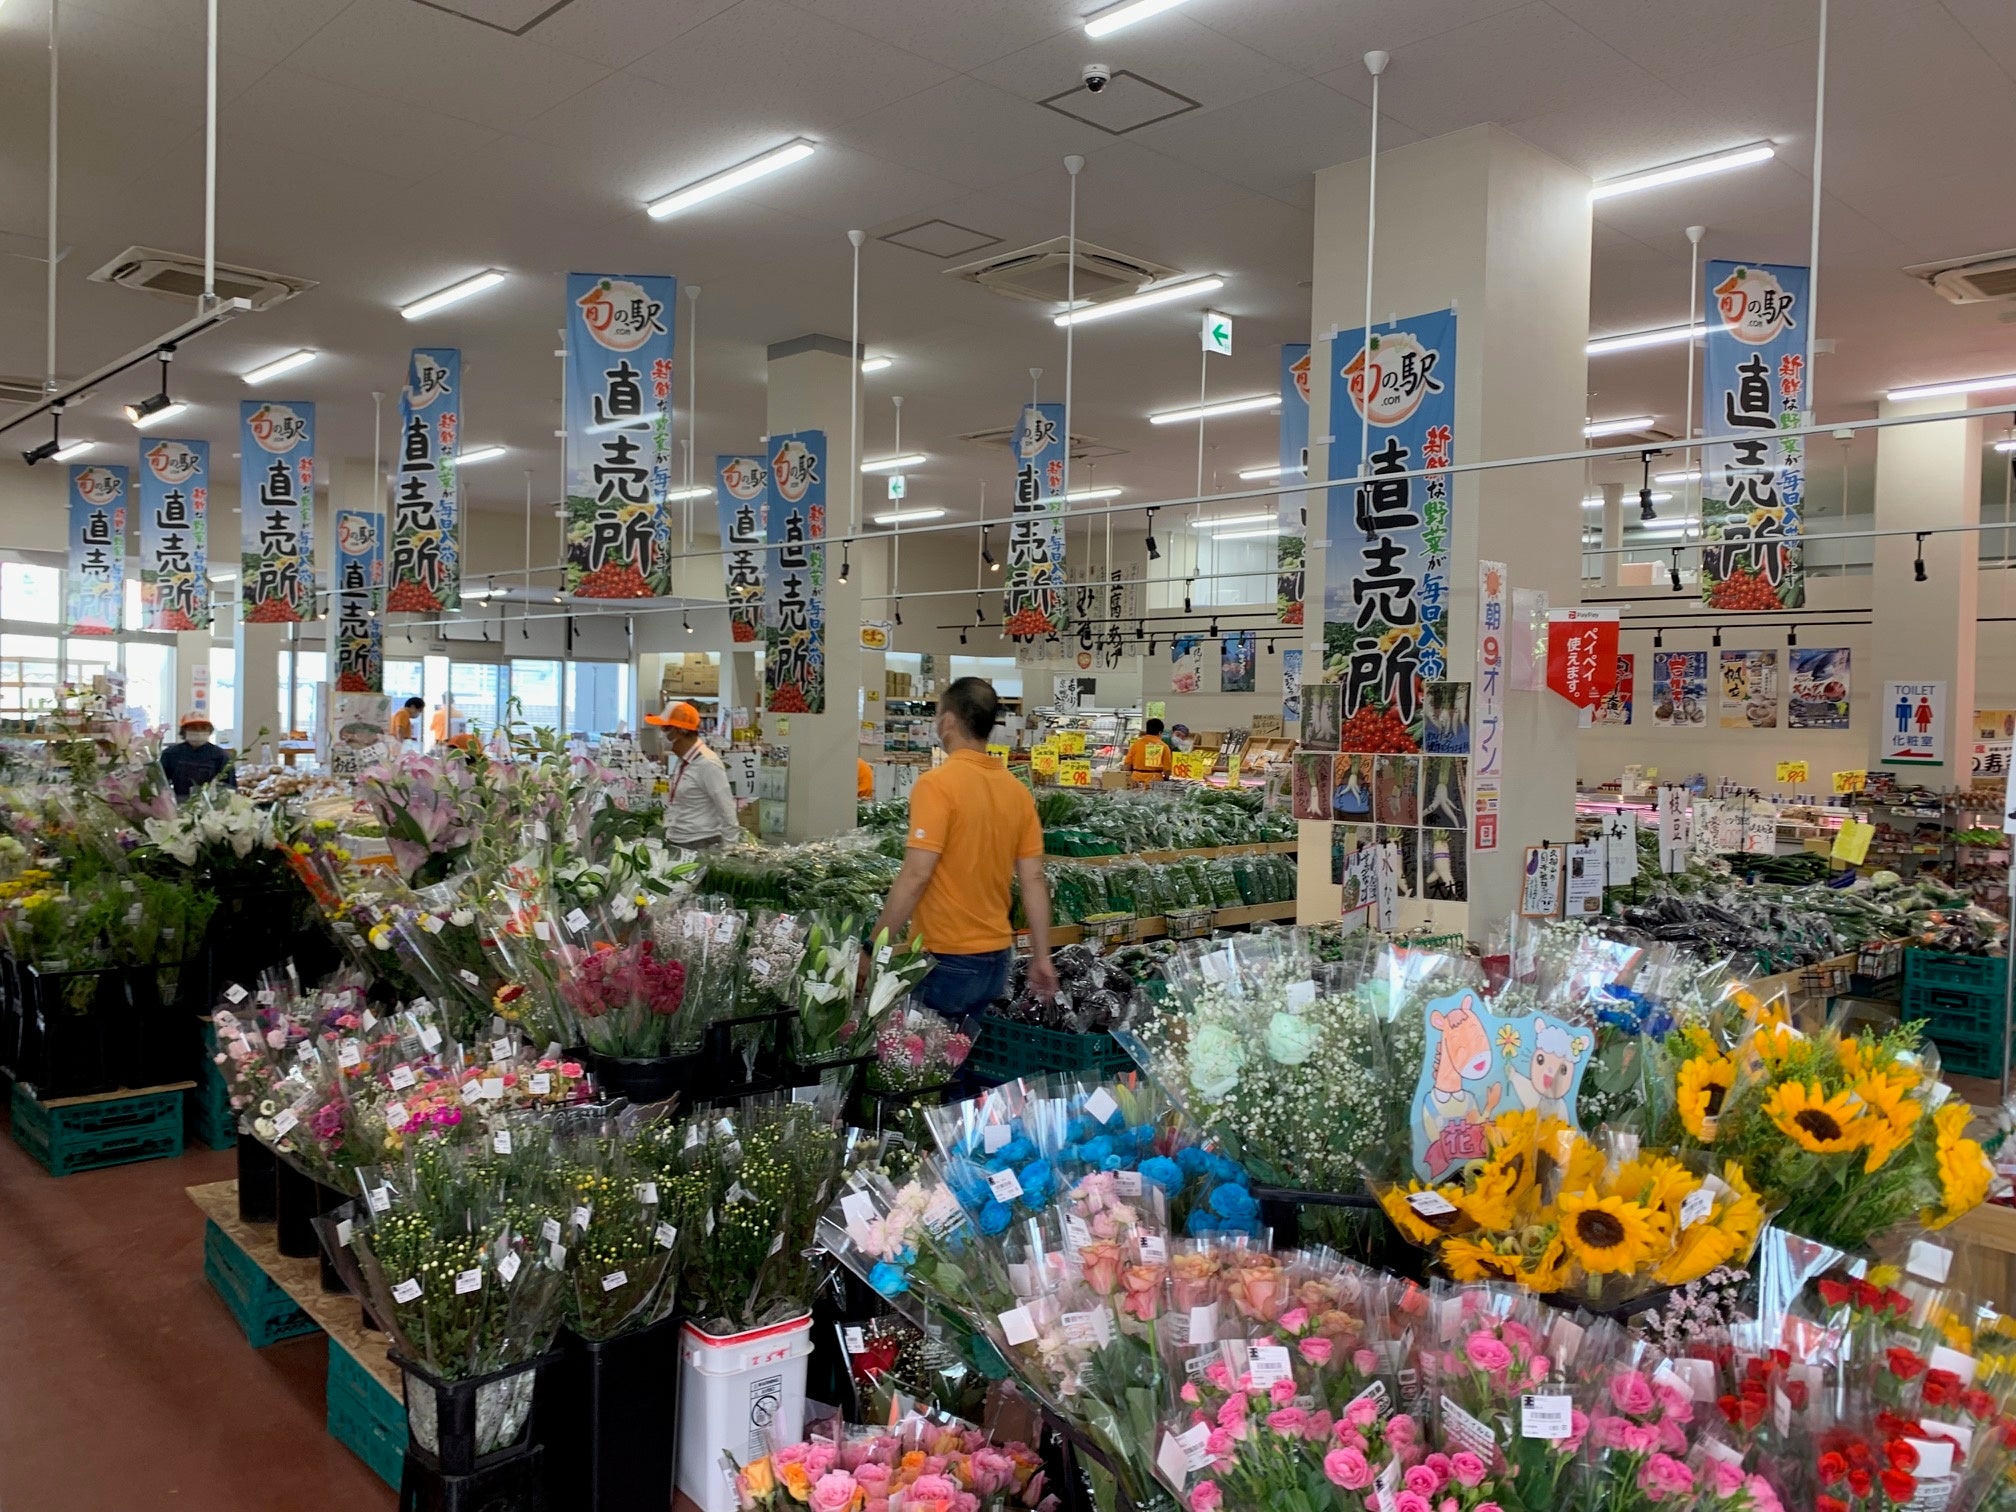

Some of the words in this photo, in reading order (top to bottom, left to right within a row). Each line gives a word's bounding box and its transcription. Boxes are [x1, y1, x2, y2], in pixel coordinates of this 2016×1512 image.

[584, 299, 666, 333] 旬の駅
[1718, 290, 1794, 327] 旬の駅
[1346, 353, 1442, 402] 旬の駅
[250, 416, 309, 440] 旬の駅
[593, 360, 653, 576] 直売所
[774, 455, 818, 487] 旬の駅
[1723, 354, 1785, 585] 直売所
[391, 416, 438, 592] 直売所
[156, 488, 195, 616] 直売所
[259, 459, 298, 607] 直売所
[1009, 464, 1052, 618] 直売所
[778, 508, 810, 694] 直売所
[1346, 438, 1419, 724] 直売所
[339, 560, 370, 679] 直売所
[1566, 637, 1582, 698] 使えます。
[1582, 626, 1599, 682] ペイペイ
[1894, 685, 1936, 696] TOILET
[1892, 735, 1934, 747] 化粧室
[741, 756, 756, 794] セロリ
[1073, 771, 1087, 785] 98
[1431, 880, 1465, 900] 大根
[1444, 1119, 1474, 1155] 花
